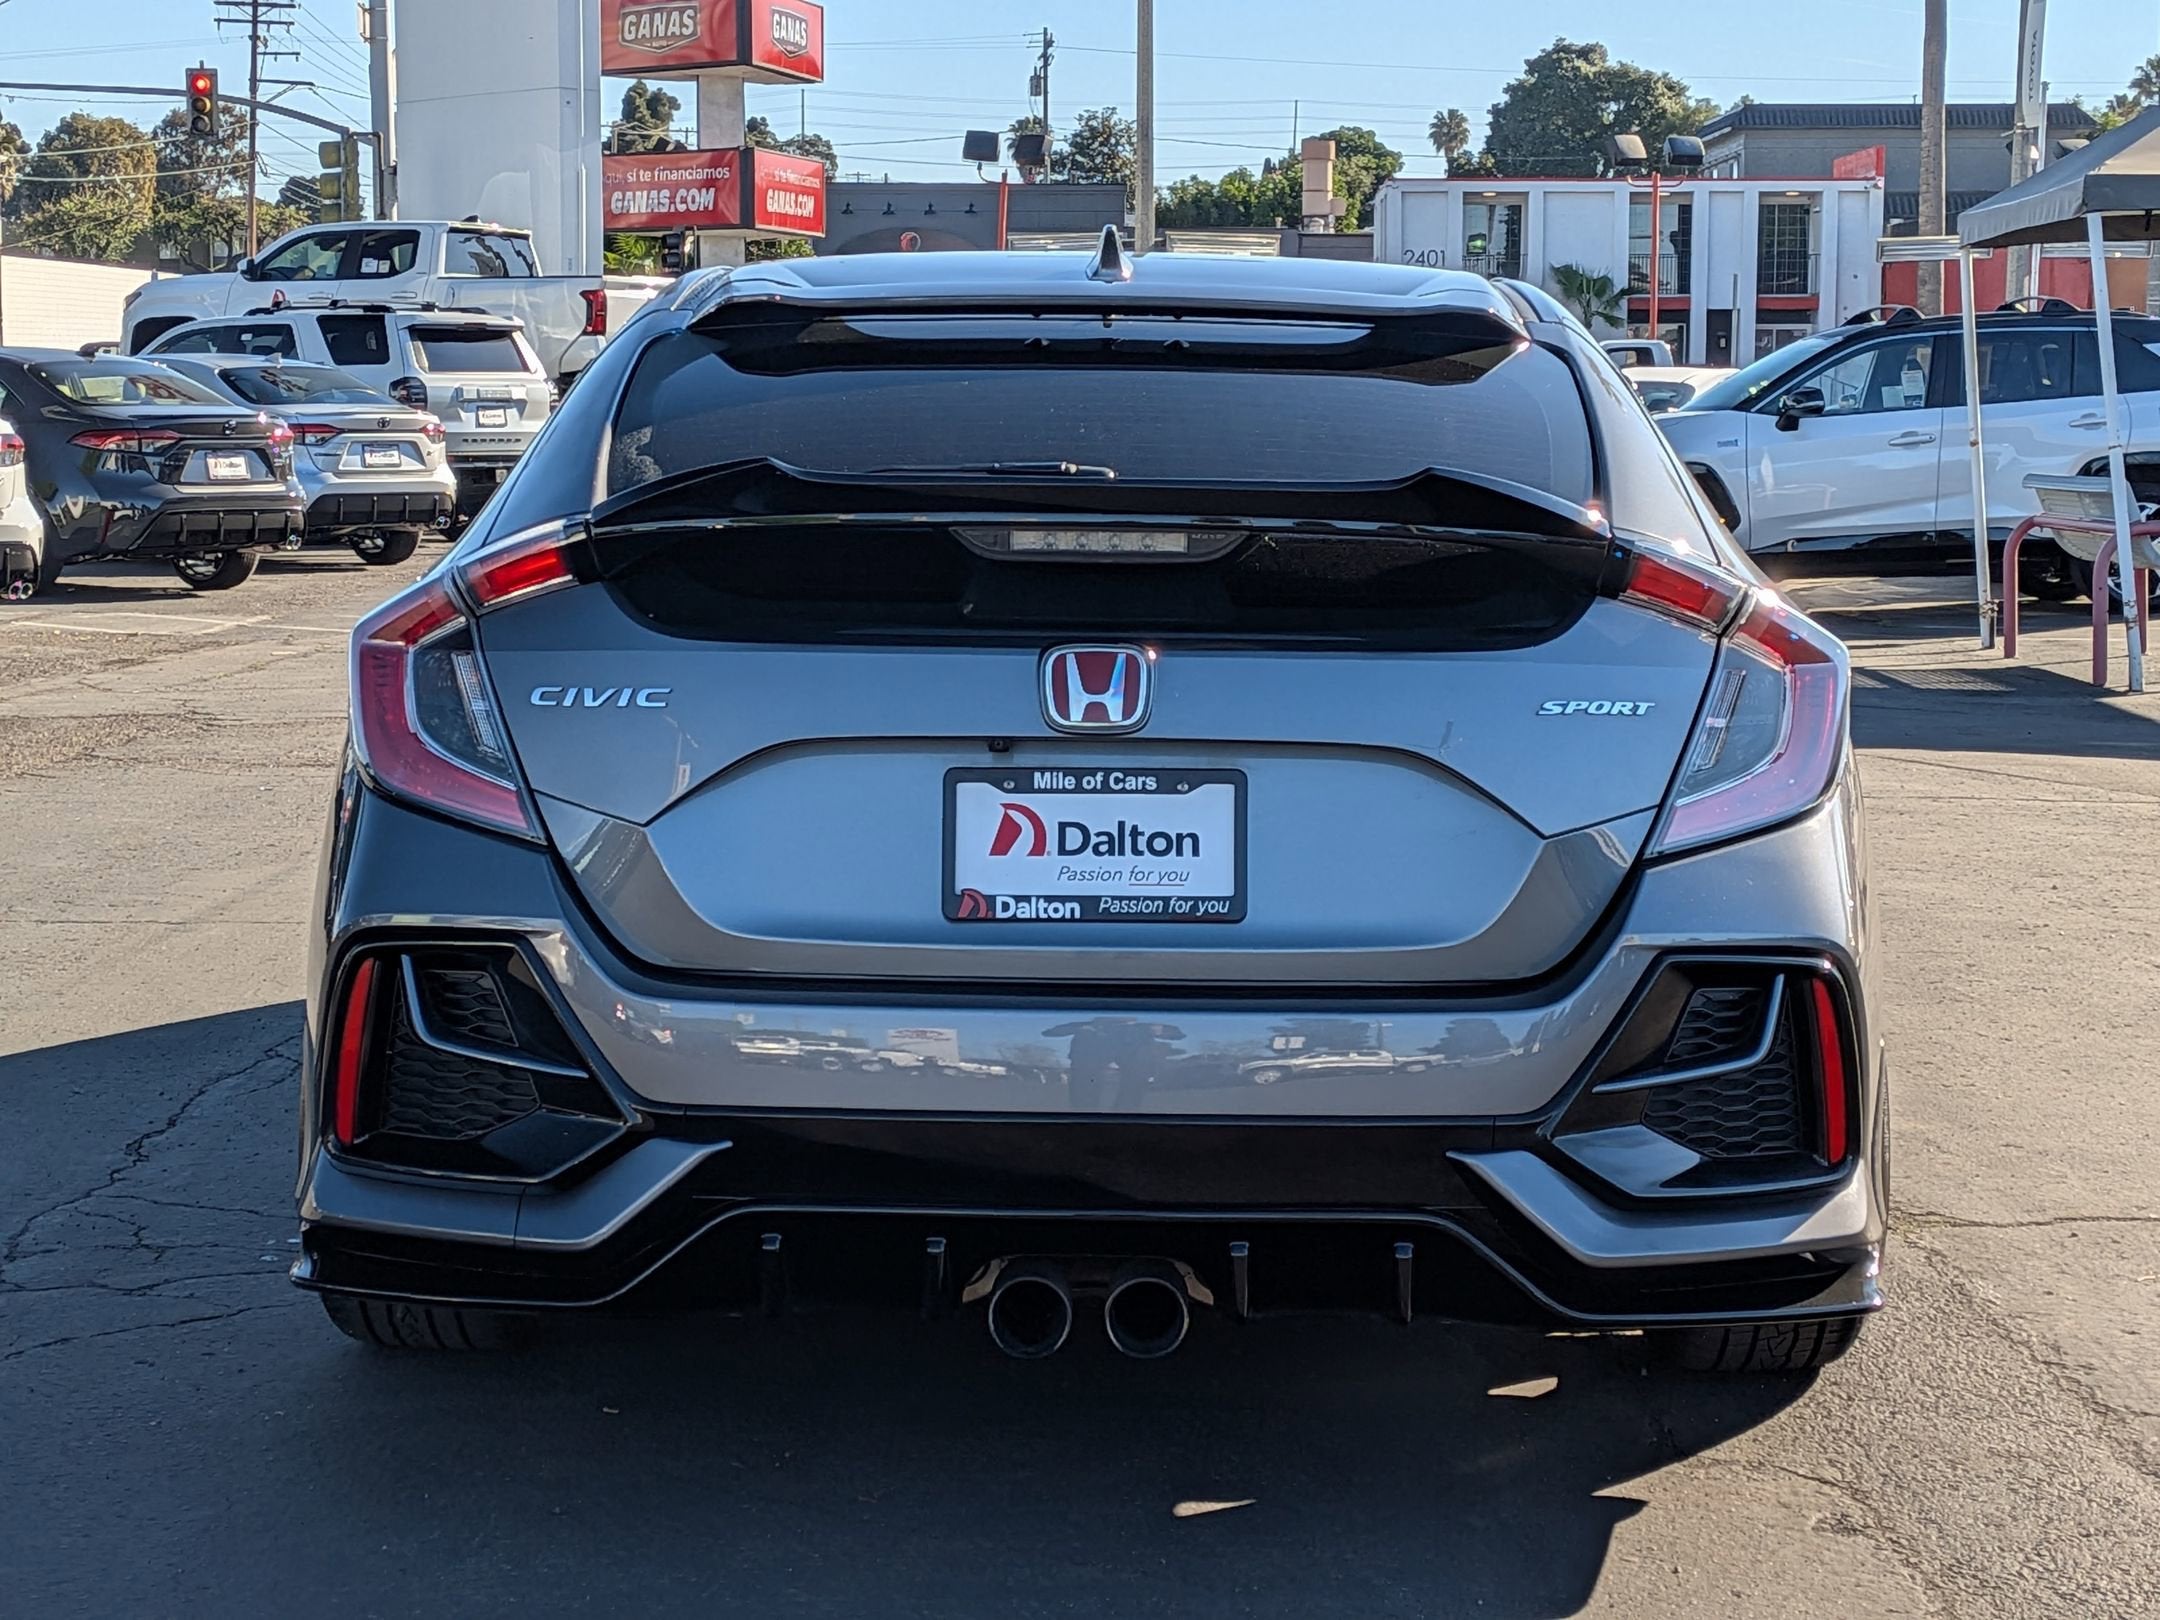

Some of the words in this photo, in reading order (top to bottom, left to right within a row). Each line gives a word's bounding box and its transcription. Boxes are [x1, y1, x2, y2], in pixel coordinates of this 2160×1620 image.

[623, 9, 695, 41] GANAS
[773, 13, 807, 47] GANAS
[627, 168, 637, 182] sí
[639, 169, 652, 182] te
[654, 165, 730, 182] financiamos
[610, 187, 716, 215] GANAS.COM
[766, 189, 815, 218] GANAS.COM
[1403, 249, 1446, 267] 2401
[530, 686, 673, 708] CIVIC
[1536, 700, 1656, 716] SPORT
[1033, 771, 1076, 790] Mile
[1082, 771, 1103, 790] of
[1109, 772, 1157, 791] Cars
[1057, 820, 1200, 857] Dalton
[1057, 866, 1123, 882] Passion
[1128, 865, 1155, 882] for
[1157, 868, 1190, 885] you
[995, 896, 1081, 919] Dalton
[1098, 897, 1164, 914] Passion
[1168, 897, 1194, 914] for
[1195, 898, 1230, 916] you
